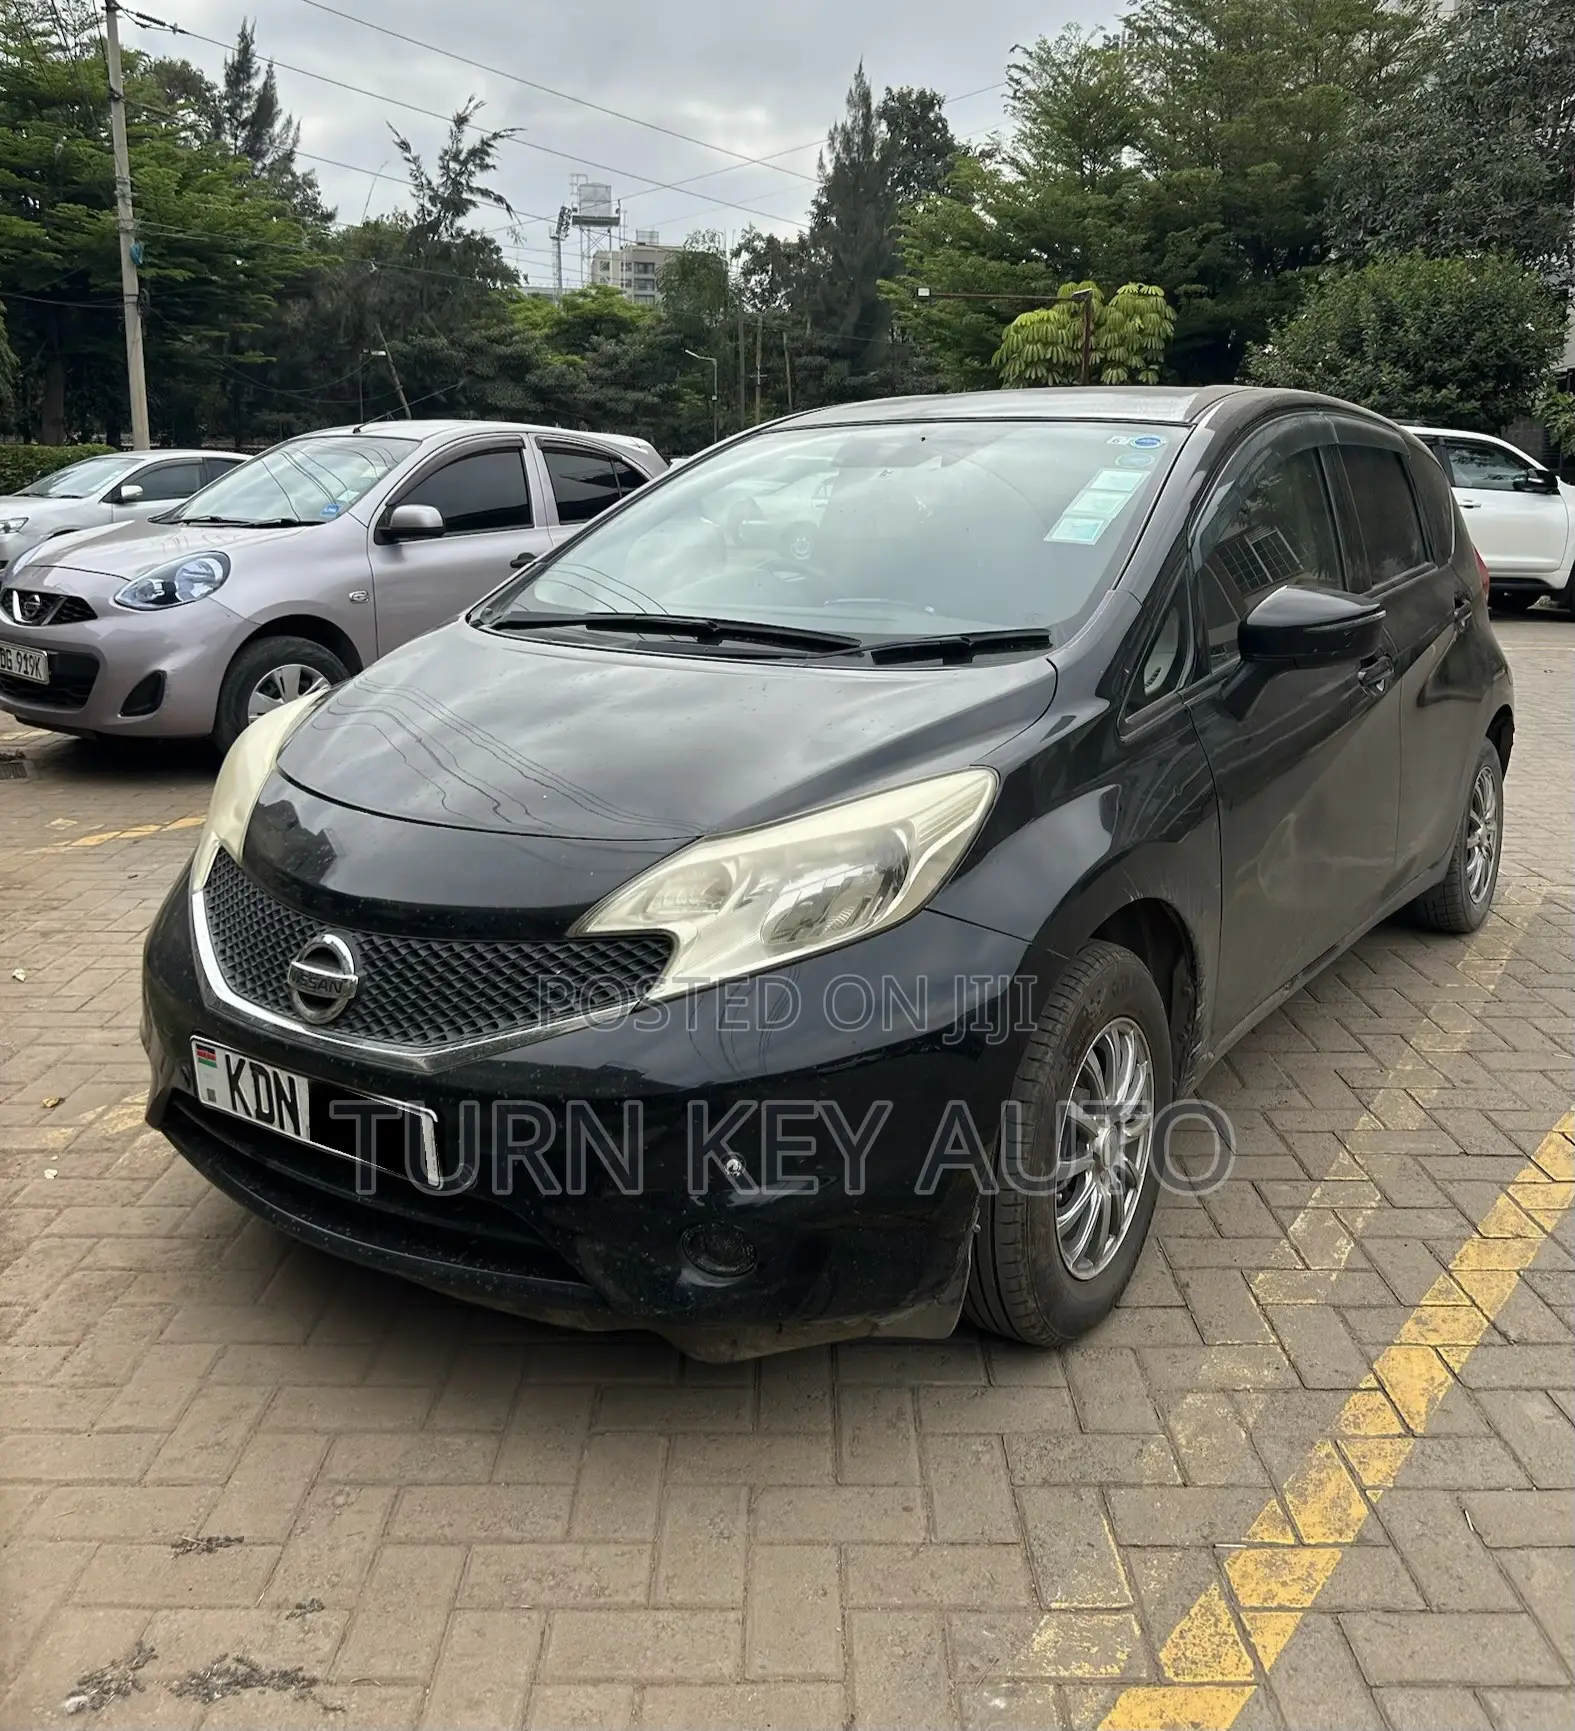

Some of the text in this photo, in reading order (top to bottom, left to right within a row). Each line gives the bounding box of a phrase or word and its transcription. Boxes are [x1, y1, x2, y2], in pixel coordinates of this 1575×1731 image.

[16, 650, 42, 679] 919K
[289, 967, 344, 993] NISSAN
[225, 1053, 301, 1137] KDN
